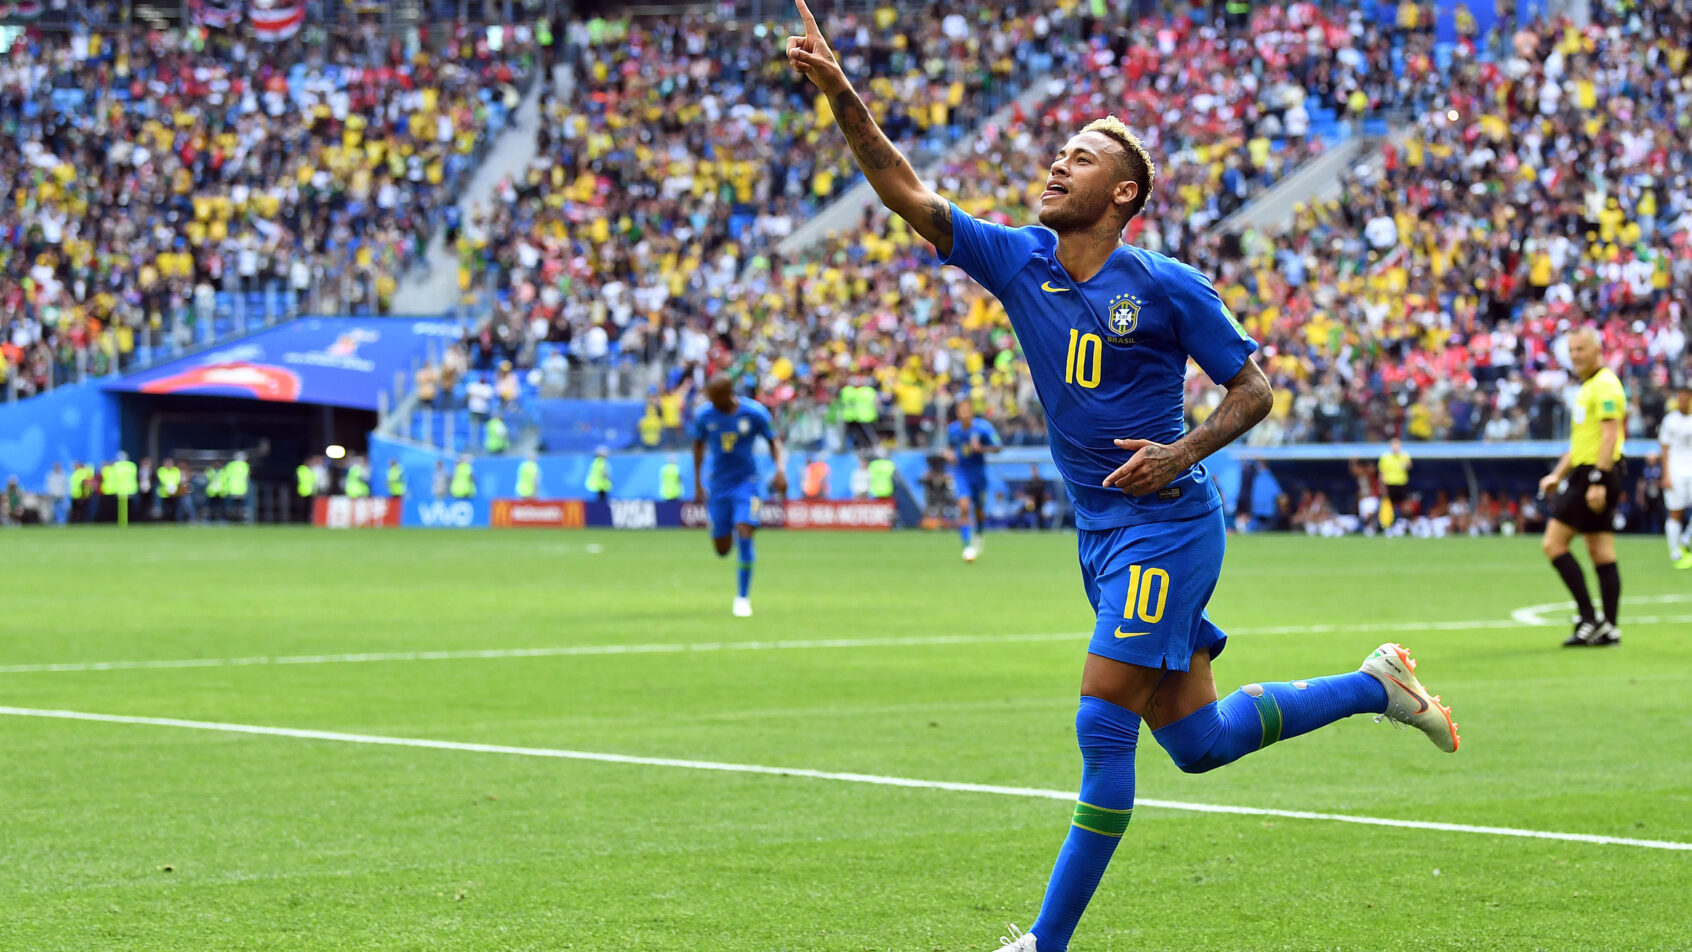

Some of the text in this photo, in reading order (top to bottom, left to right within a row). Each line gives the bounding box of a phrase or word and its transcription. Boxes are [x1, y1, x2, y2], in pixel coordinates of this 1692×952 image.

[1065, 328, 1103, 389] 10
[1107, 336, 1135, 344] BRASIL
[609, 499, 657, 528] VISA
[1123, 565, 1170, 624] 10
